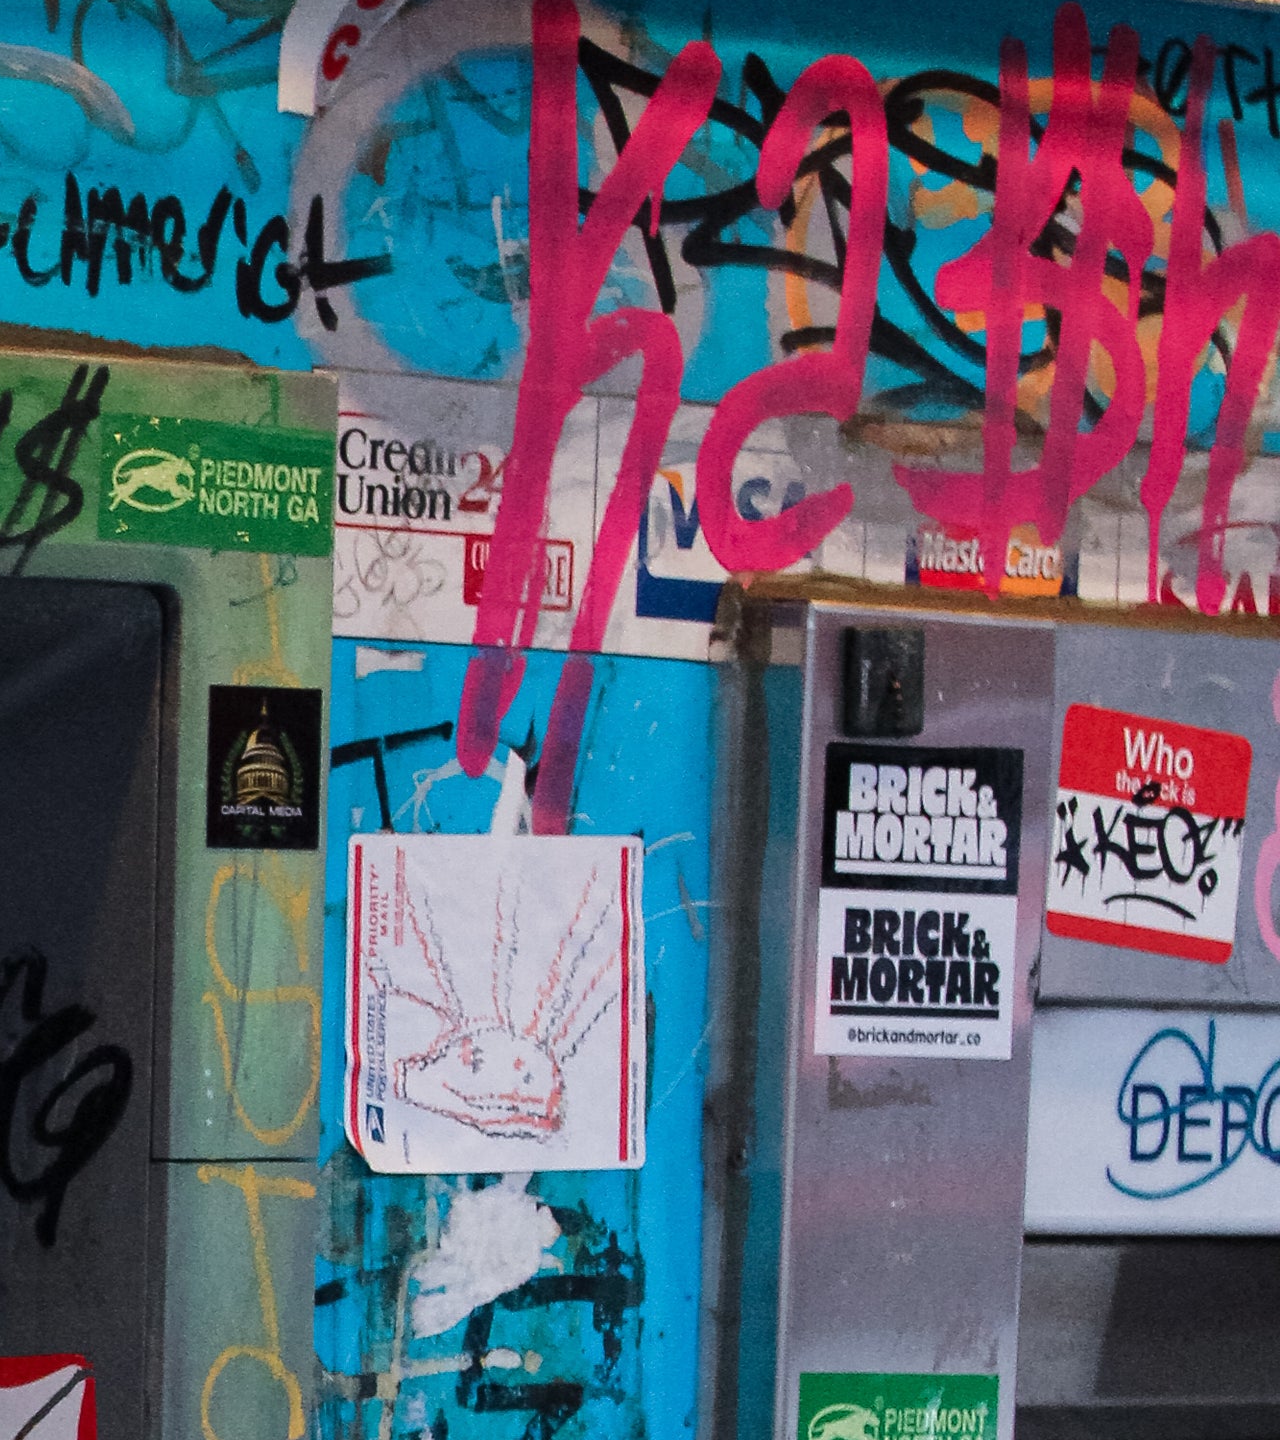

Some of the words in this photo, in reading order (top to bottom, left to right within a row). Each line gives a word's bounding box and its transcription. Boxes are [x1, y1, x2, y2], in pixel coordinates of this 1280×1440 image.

[199, 458, 322, 495] PIEDMONT
[337, 473, 453, 522] Union
[198, 488, 280, 521] NORTH
[286, 495, 320, 524] GA
[919, 528, 1064, 580] MastCard
[1123, 726, 1194, 781] Who
[221, 804, 265, 817] CAPITAL
[268, 806, 303, 818] MEDIA
[1115, 770, 1141, 795] the
[1181, 786, 1196, 807] is
[835, 809, 1008, 867] MORTAR
[368, 872, 379, 958] PRIORITY
[379, 892, 389, 937] MAIL
[830, 956, 1000, 1006] MORTAR
[366, 994, 376, 1046] STATES
[376, 990, 387, 1047] SERVICE
[847, 1026, 982, 1047] @brickandmortar_co
[366, 1047, 376, 1098] UNITED
[376, 1048, 387, 1102] POSTAL
[883, 1408, 989, 1434] PIEDMONT
